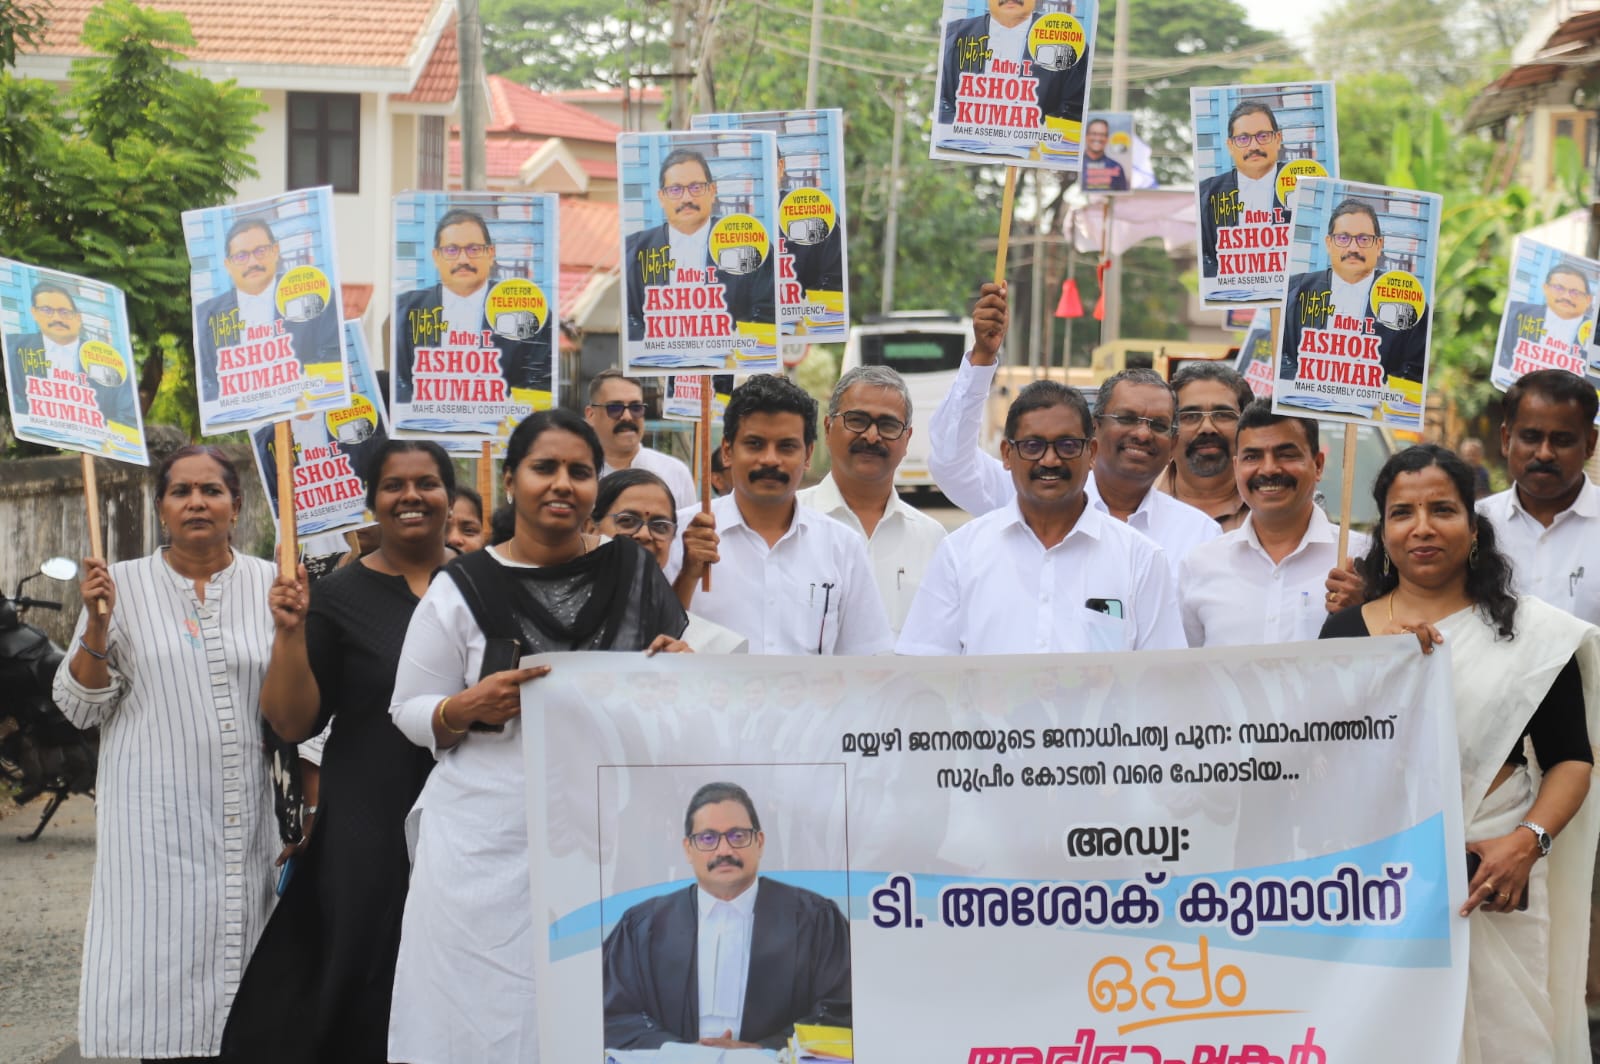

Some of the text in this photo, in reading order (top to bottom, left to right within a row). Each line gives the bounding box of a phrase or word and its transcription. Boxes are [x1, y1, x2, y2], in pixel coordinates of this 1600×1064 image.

[1045, 20, 1072, 28] VOTE FOR
[1034, 28, 1082, 42] TELEVISION
[992, 58, 1032, 76] Adv: T.
[958, 75, 1036, 102] ASHOK
[956, 102, 1039, 128] KUMAR
[953, 125, 1062, 142] MAHE ASSEMBLY COSTITUENCY
[1290, 166, 1316, 175] VOTE FOR
[793, 196, 807, 204] VOTE
[784, 204, 832, 216] TELEVISION
[1245, 208, 1284, 224] Adv: T.
[724, 222, 753, 230] VOTE FOR
[714, 232, 765, 244] TELEVISION
[1218, 227, 1290, 250] ASHOK
[288, 272, 314, 283] VOTE FOR
[677, 267, 718, 283] Adv: T.
[1218, 277, 1236, 286] MAHE
[1238, 275, 1272, 284] ASSEMBLY
[1387, 278, 1414, 288] VOTE FOR
[280, 280, 326, 297] TELEVISION
[502, 288, 532, 296] VOTE FOR
[1376, 286, 1422, 302] TELEVISION
[492, 297, 543, 308] TELEVISION
[646, 286, 726, 311] ASHOK
[782, 306, 824, 316] OSTITUENCY
[247, 319, 286, 341] Adv: T.
[646, 314, 731, 338] KUMAR
[1334, 314, 1376, 334] Adv: T.
[449, 330, 494, 346] Adv: T.
[644, 338, 757, 350] MAHE ASSEMBLY COSTITUENCY
[1300, 330, 1380, 360] ASHOK
[84, 350, 124, 368] TELEVISION
[219, 336, 292, 372] ASHOK
[415, 350, 500, 374] ASHOK
[1516, 340, 1584, 376] ASHOK
[54, 368, 90, 386] Adv: T.
[220, 360, 300, 396] KUMAR
[1298, 358, 1382, 388] KUMAR
[28, 378, 96, 408] ASHOK
[220, 380, 324, 408] MAHE ASSEMBLY COSTITUENCY
[416, 379, 505, 402] KUMAR
[675, 386, 701, 400] KUM
[1294, 382, 1404, 402] MAHE ASSEMBLY COSTITUENCY
[30, 398, 104, 428] KUMAR
[330, 404, 372, 422] TELEVISION
[412, 404, 530, 416] MAHE ASSEMBLY COSTITUENCY
[30, 417, 48, 426] MAHE
[50, 420, 82, 432] ASSEMBLY
[304, 442, 341, 462] Adv: T.
[294, 456, 352, 488] SHOK
[294, 478, 362, 512] KUMAR
[310, 505, 342, 516] ASSEMBLY
[842, 728, 902, 757] മയ്യഴി
[909, 729, 1035, 754] ജനതയുടെ
[1042, 723, 1168, 751] ജനാധിപത്യ
[1239, 715, 1398, 744] സ്ഥാപനത്തിന്
[937, 758, 1300, 792] സുപ്രീം കോടതി വരെ പോരാടിയ...
[873, 866, 1408, 936] ടി. അശോക് കുമാറിന്
[1088, 935, 1247, 1014] ഒപ്പം
